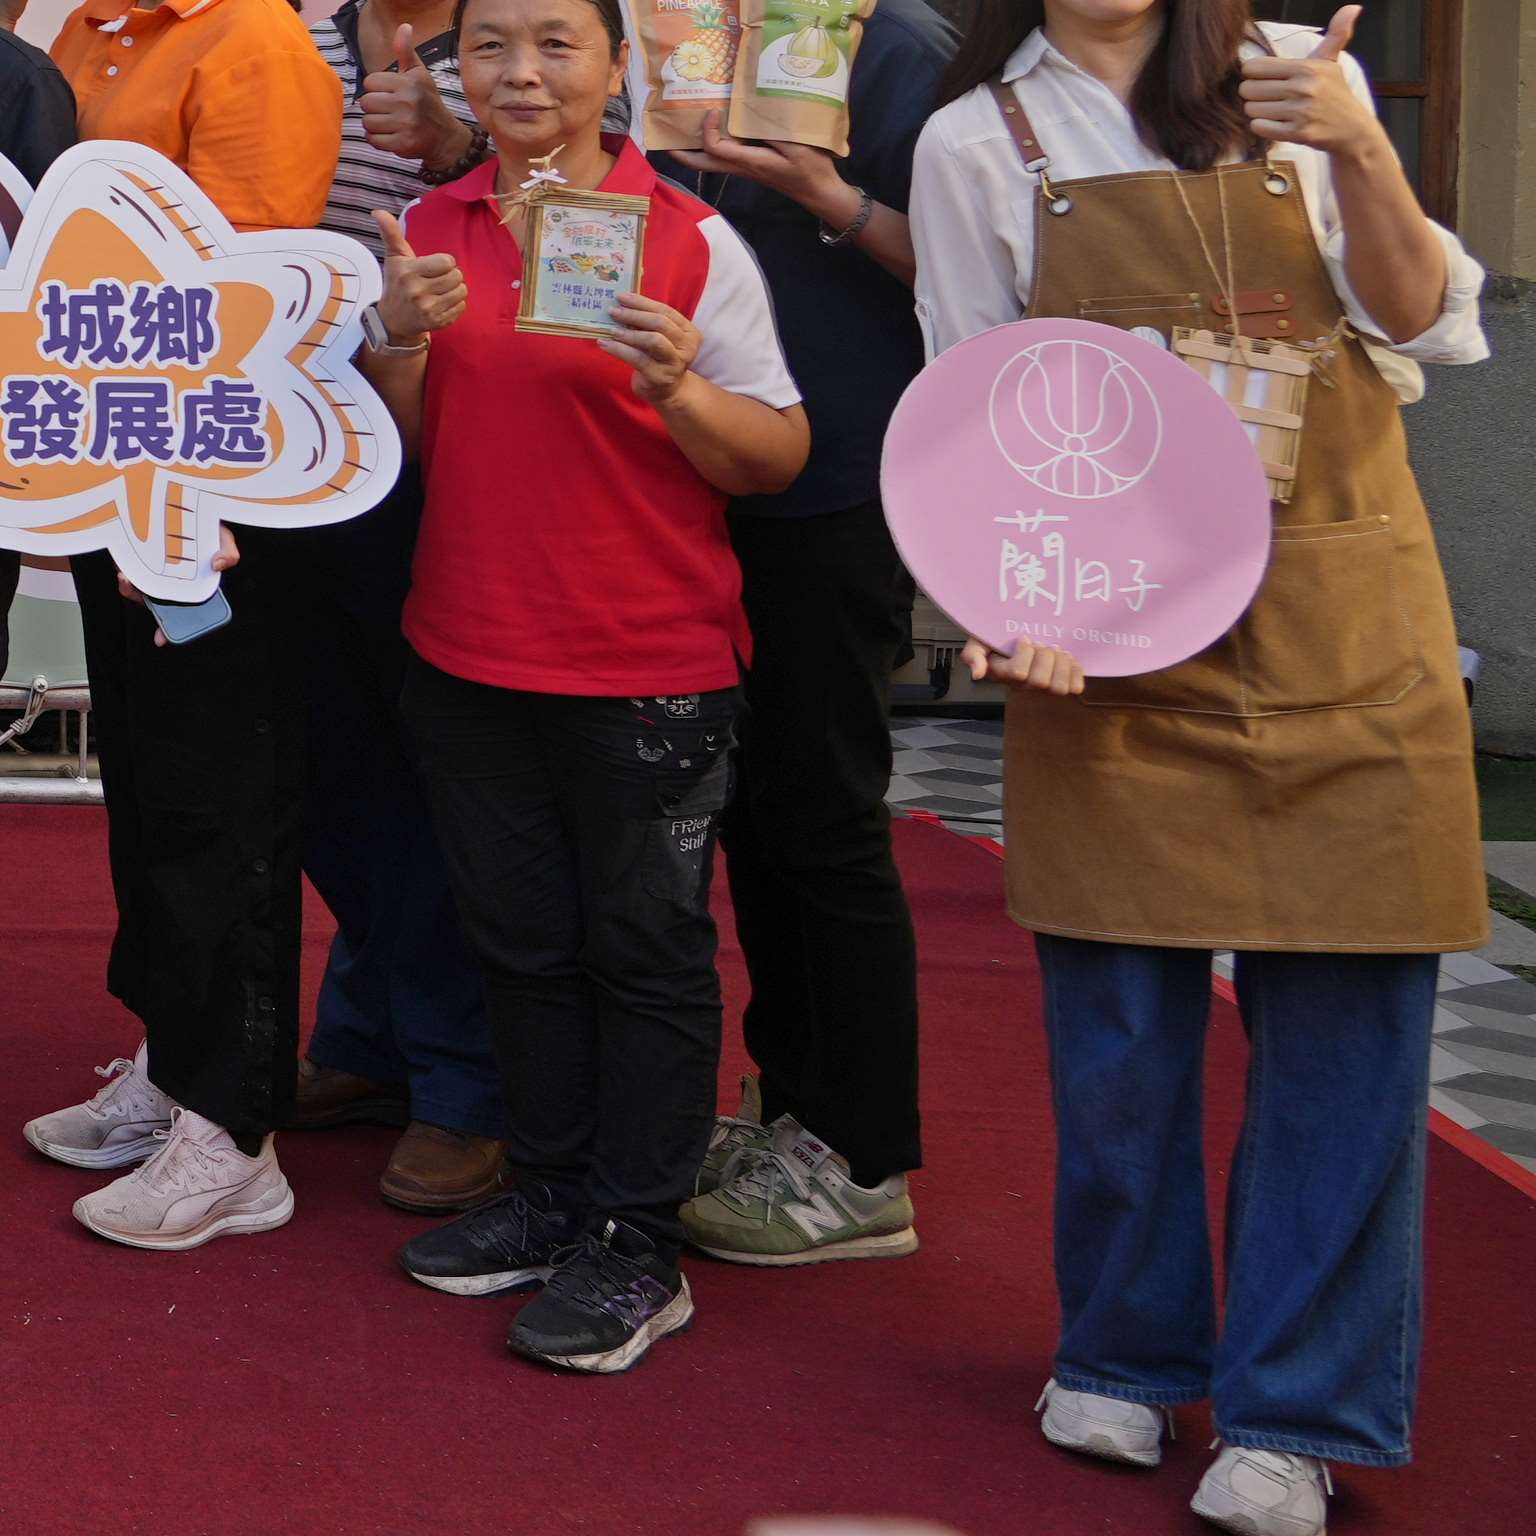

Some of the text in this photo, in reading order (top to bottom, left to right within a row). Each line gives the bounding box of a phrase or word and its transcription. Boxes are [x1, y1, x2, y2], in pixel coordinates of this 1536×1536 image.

[41, 284, 215, 365] 城鄉
[0, 379, 267, 463] 發展處
[1005, 618, 1153, 649] DAILY ORCHID
